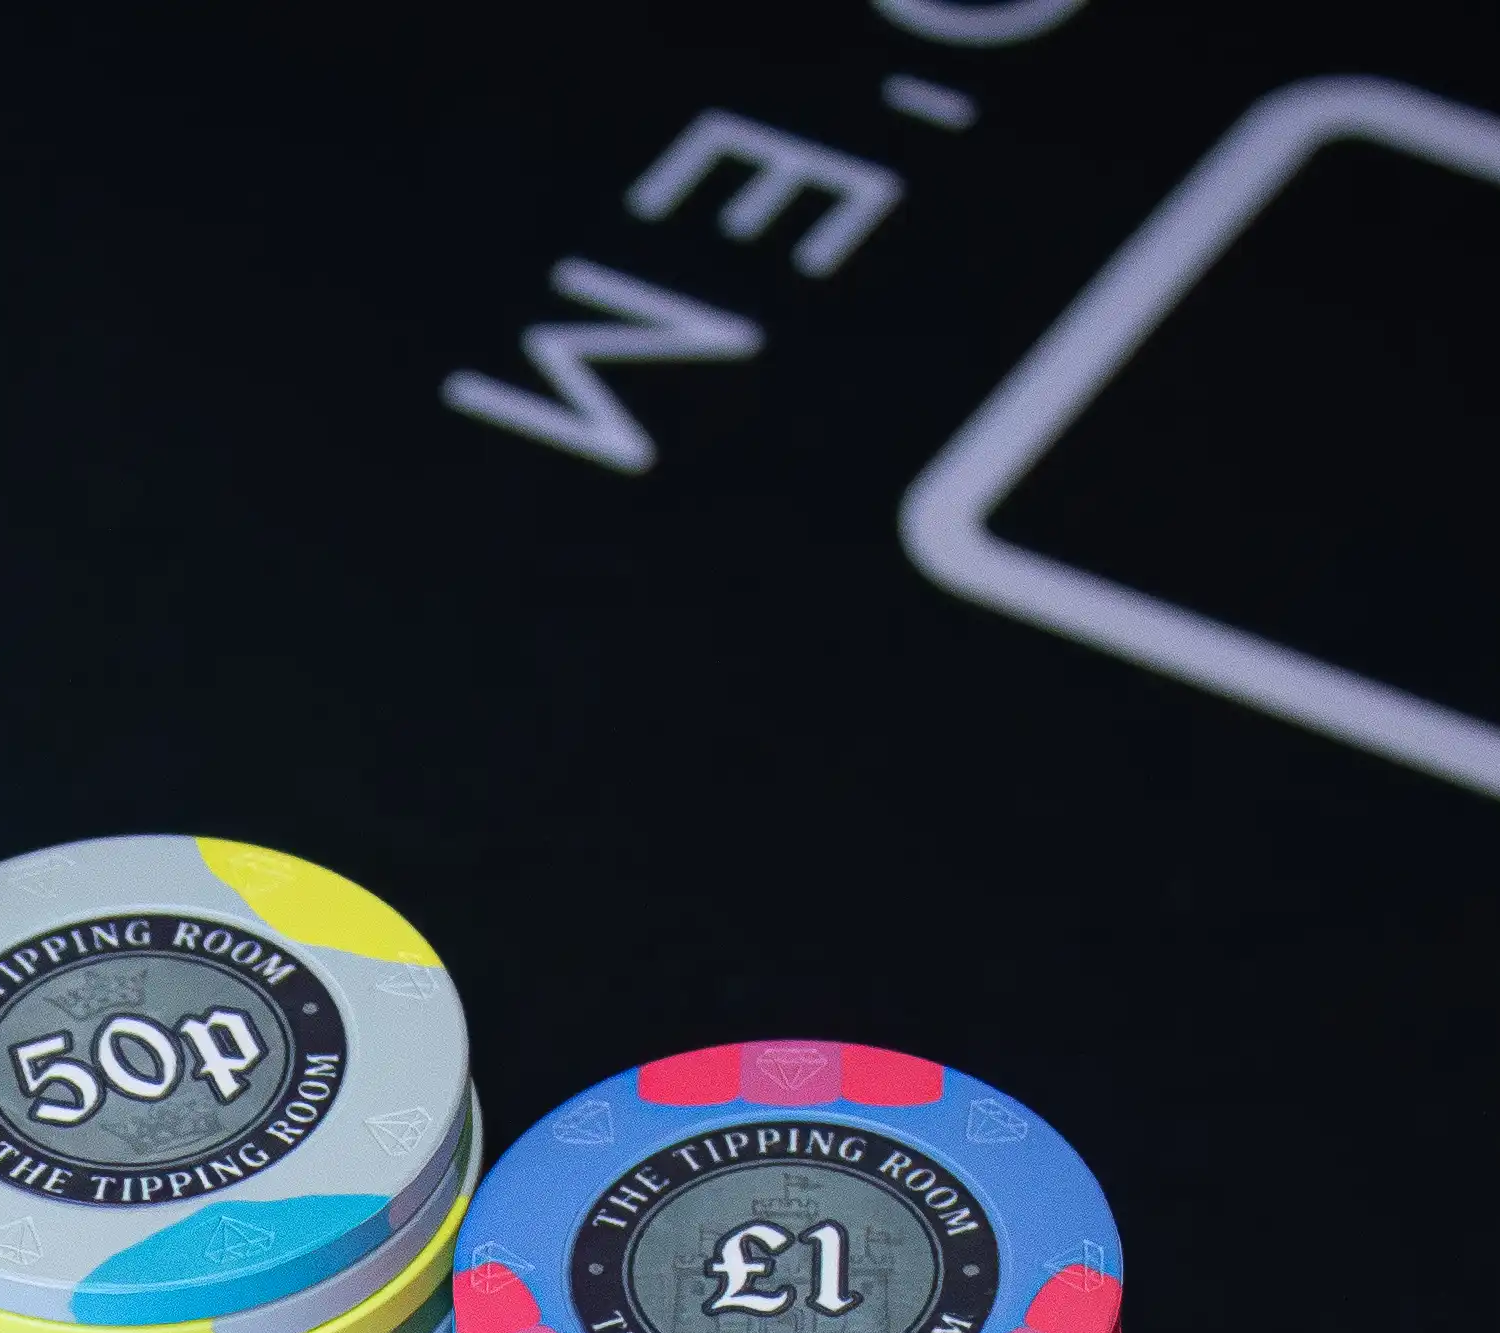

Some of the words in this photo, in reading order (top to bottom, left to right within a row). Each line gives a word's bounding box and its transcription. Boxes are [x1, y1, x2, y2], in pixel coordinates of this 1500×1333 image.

[440, 0, 1084, 476] 'EM
[173, 922, 295, 986] ROOM
[10, 1004, 268, 1127] 50p
[91, 1144, 270, 1201] TIPPING
[264, 1051, 340, 1145] ROOM
[592, 1164, 670, 1232] THE
[671, 1129, 866, 1172] TIPPING
[880, 1148, 980, 1237] ROOM
[704, 1219, 863, 1317] £1
